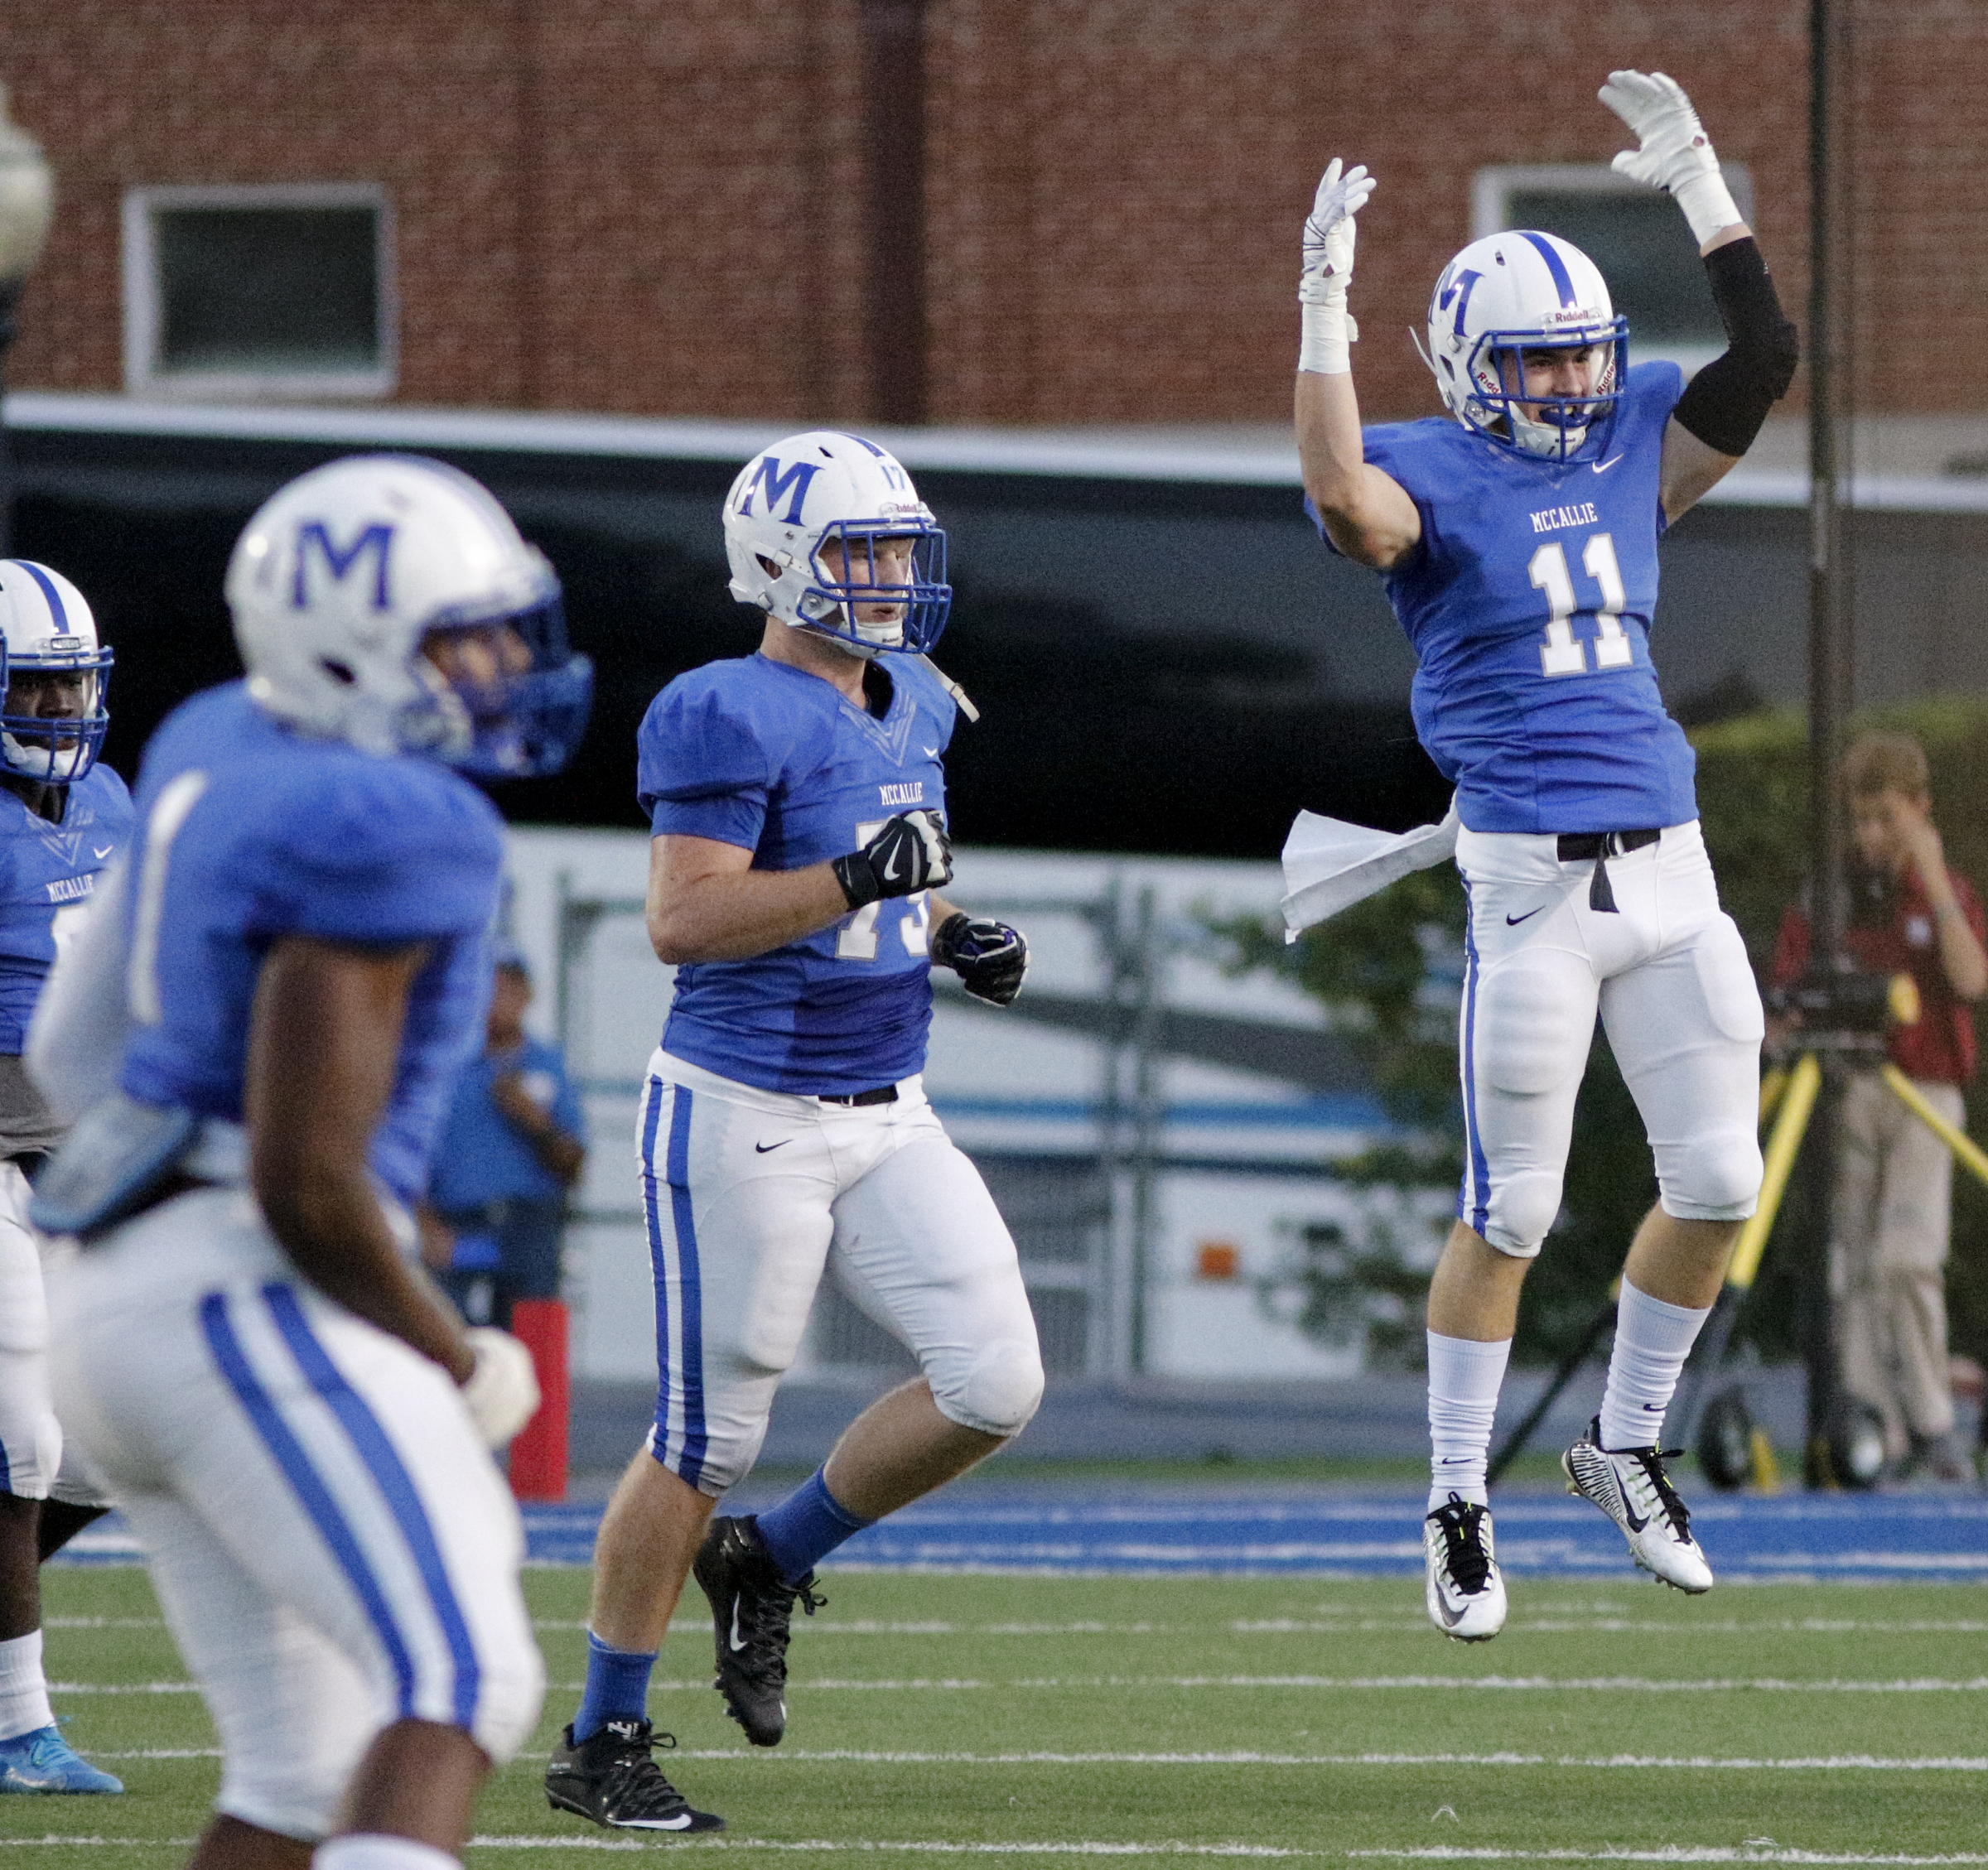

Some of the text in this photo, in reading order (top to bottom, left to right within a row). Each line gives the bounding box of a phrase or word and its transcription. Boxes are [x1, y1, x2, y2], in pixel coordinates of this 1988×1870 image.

[1555, 310, 1589, 323] Riddell
[1476, 371, 1502, 394] Ridd
[737, 456, 825, 528] M
[879, 465, 907, 491] 17
[1529, 502, 1599, 533] MCCALLIE
[292, 522, 397, 611] M
[1527, 532, 1633, 677] 11
[879, 781, 924, 806] MCCALLIE
